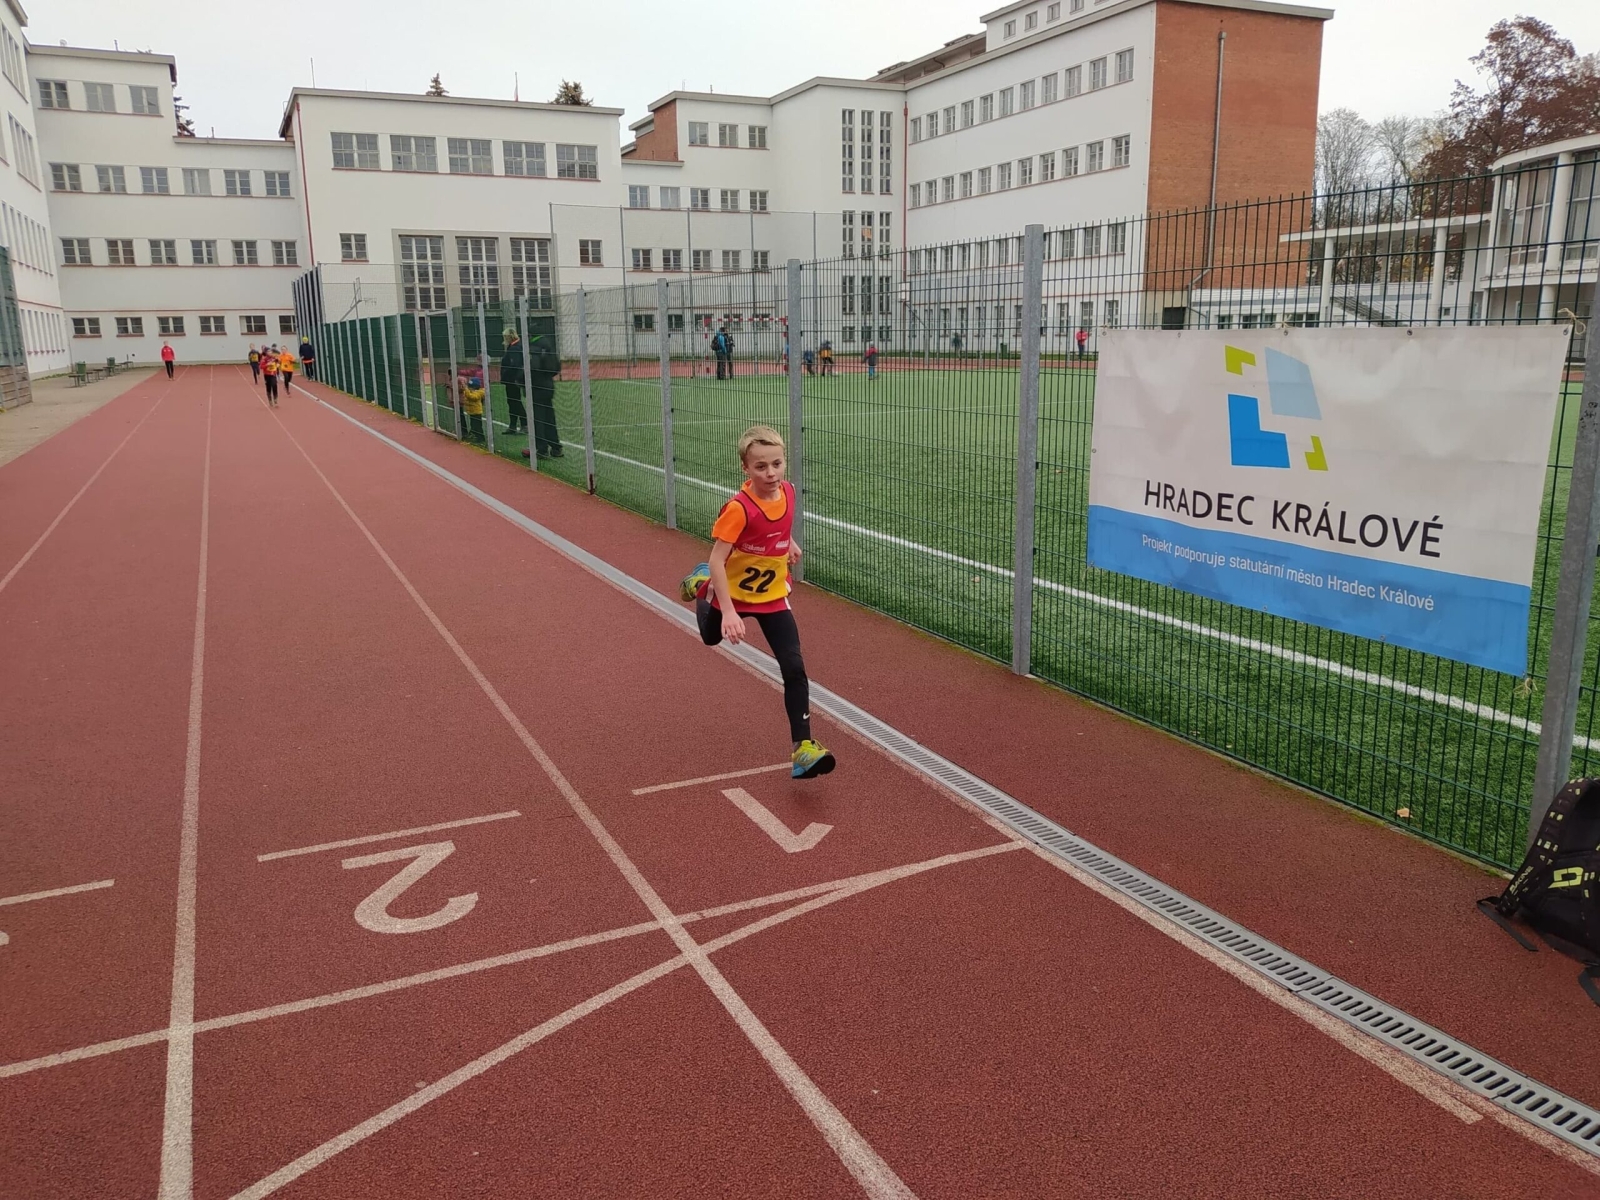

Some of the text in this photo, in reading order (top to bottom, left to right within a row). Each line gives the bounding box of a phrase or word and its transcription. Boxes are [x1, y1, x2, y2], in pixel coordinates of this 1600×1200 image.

[1144, 479, 1444, 559] HRADEC KRÁLOVÉ
[738, 566, 777, 594] 22
[1142, 533, 1435, 611] Projekt podporuje statutární město Hradec Králové
[341, 839, 479, 934] 2
